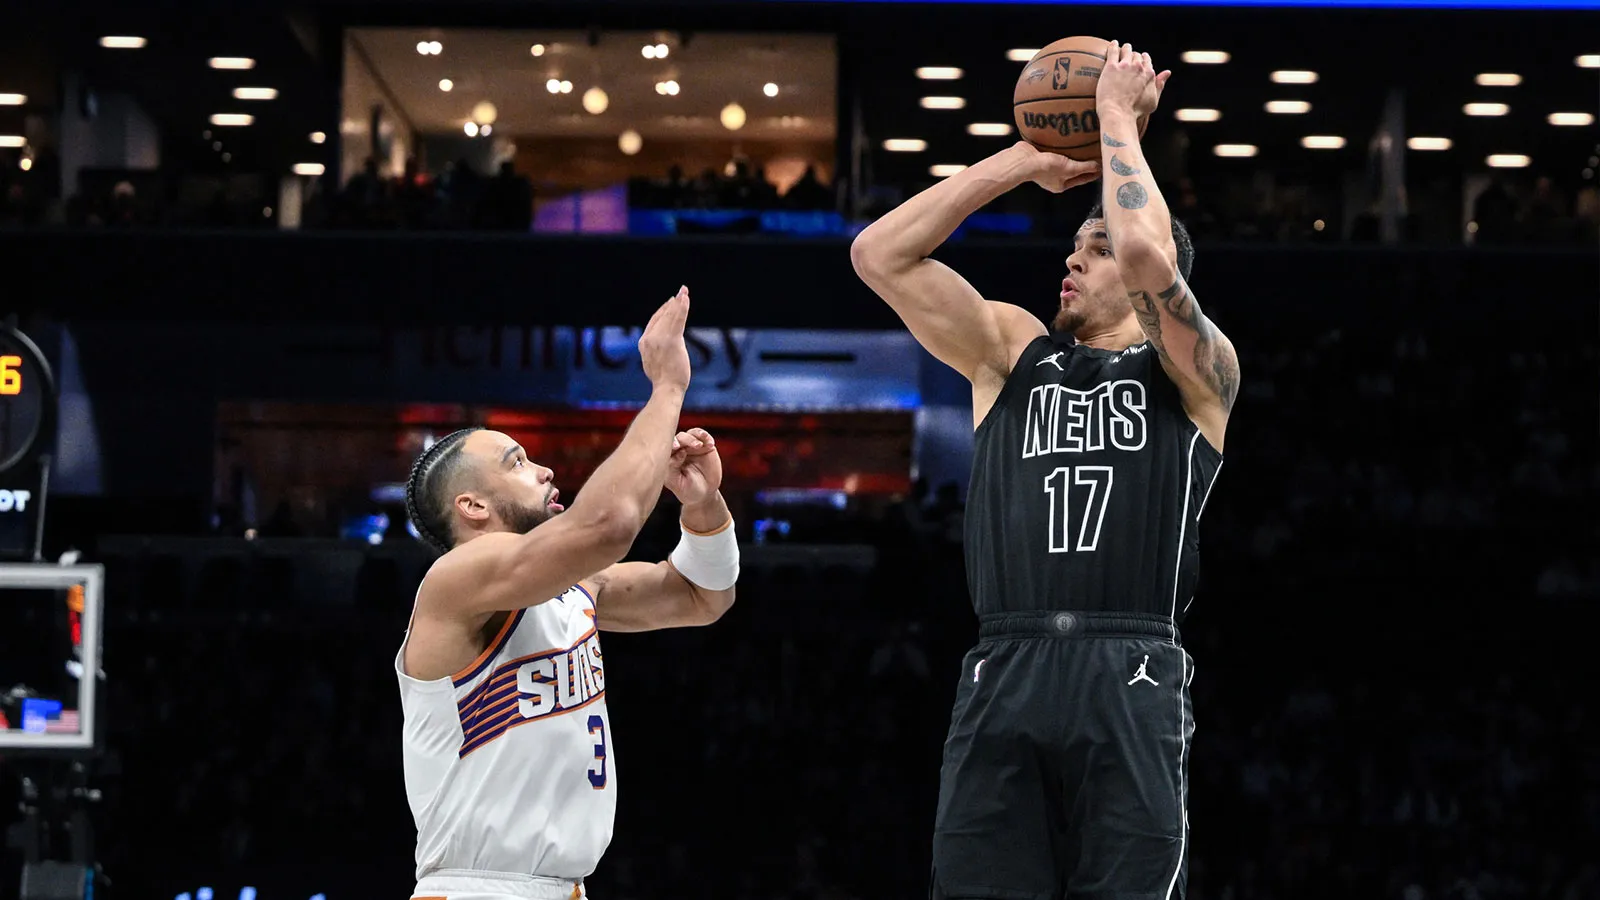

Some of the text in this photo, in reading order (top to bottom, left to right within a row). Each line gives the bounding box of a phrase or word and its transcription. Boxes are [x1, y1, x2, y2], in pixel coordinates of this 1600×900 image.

[0, 355, 22, 395] 6
[1022, 379, 1147, 459] NETS
[1044, 465, 1113, 553] 17
[516, 637, 605, 719] SUNS
[587, 715, 606, 790] 3
